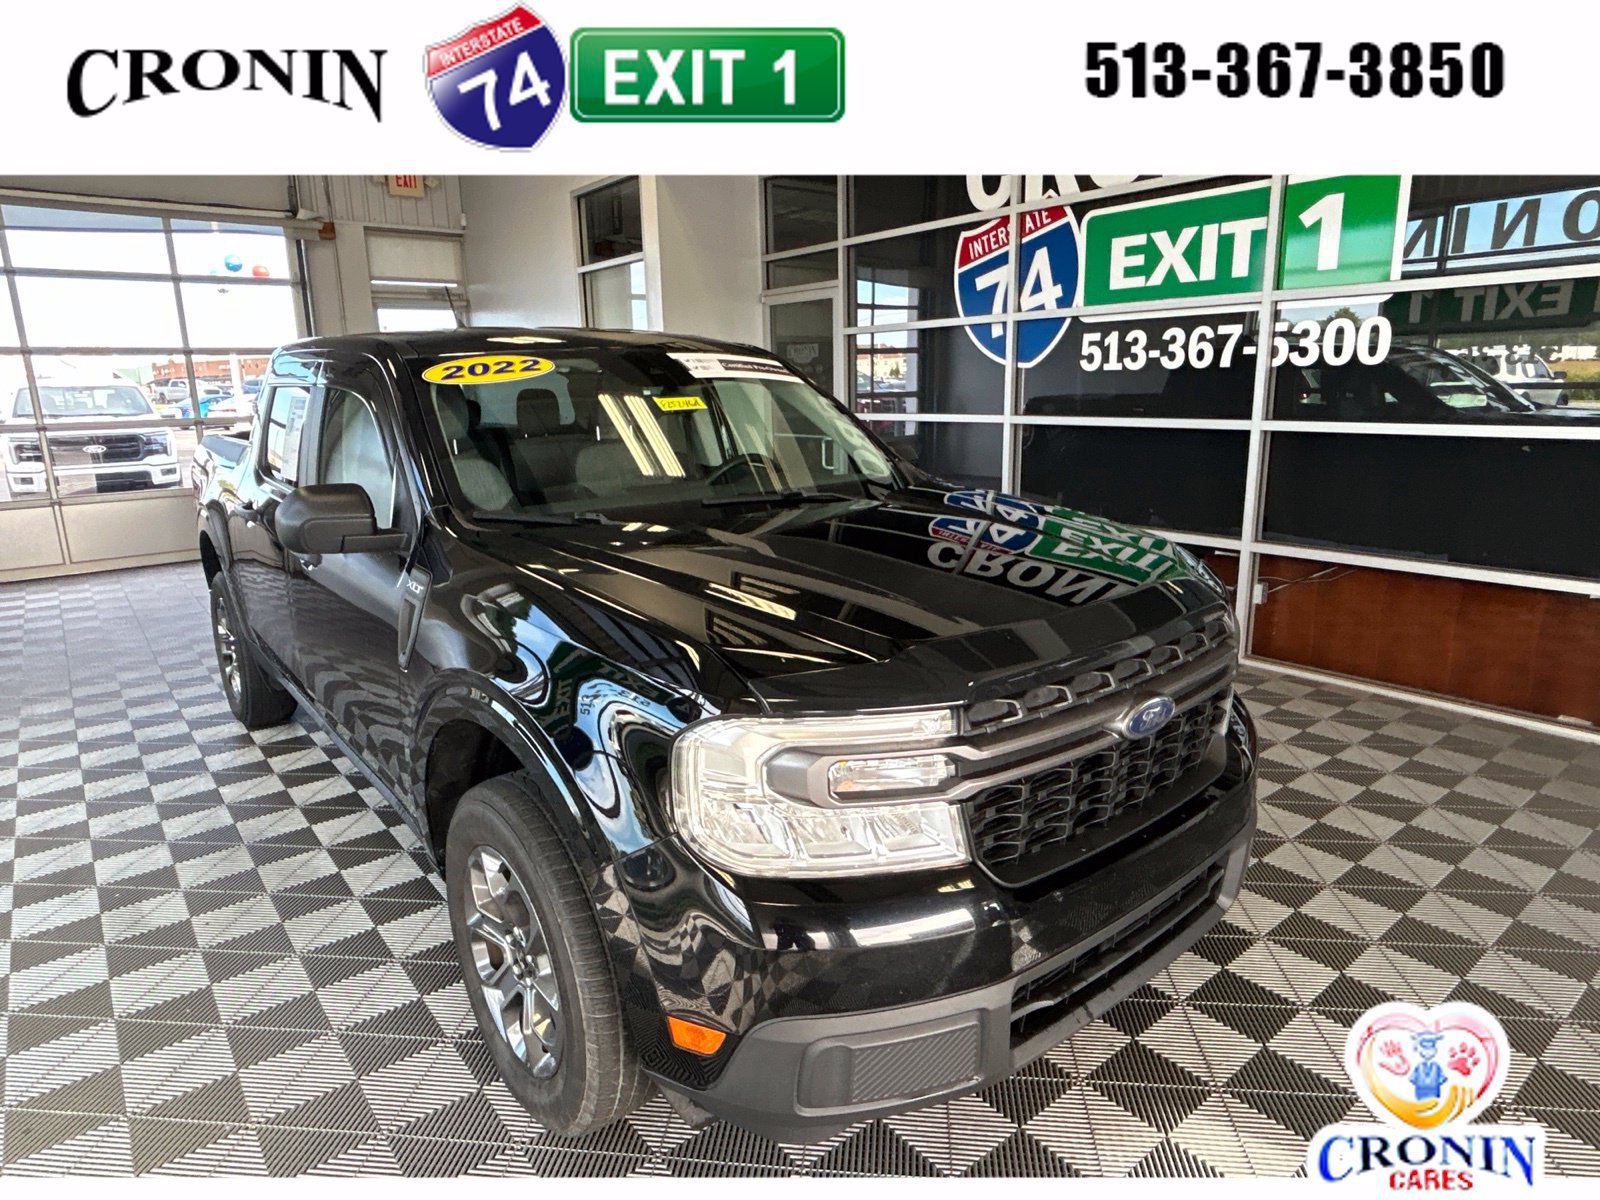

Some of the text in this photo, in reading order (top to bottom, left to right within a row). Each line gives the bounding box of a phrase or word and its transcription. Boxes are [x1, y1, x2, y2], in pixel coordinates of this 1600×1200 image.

[1108, 192, 1346, 291] EXIT 1
[974, 246, 1063, 339] 74
[440, 358, 543, 381] 2022
